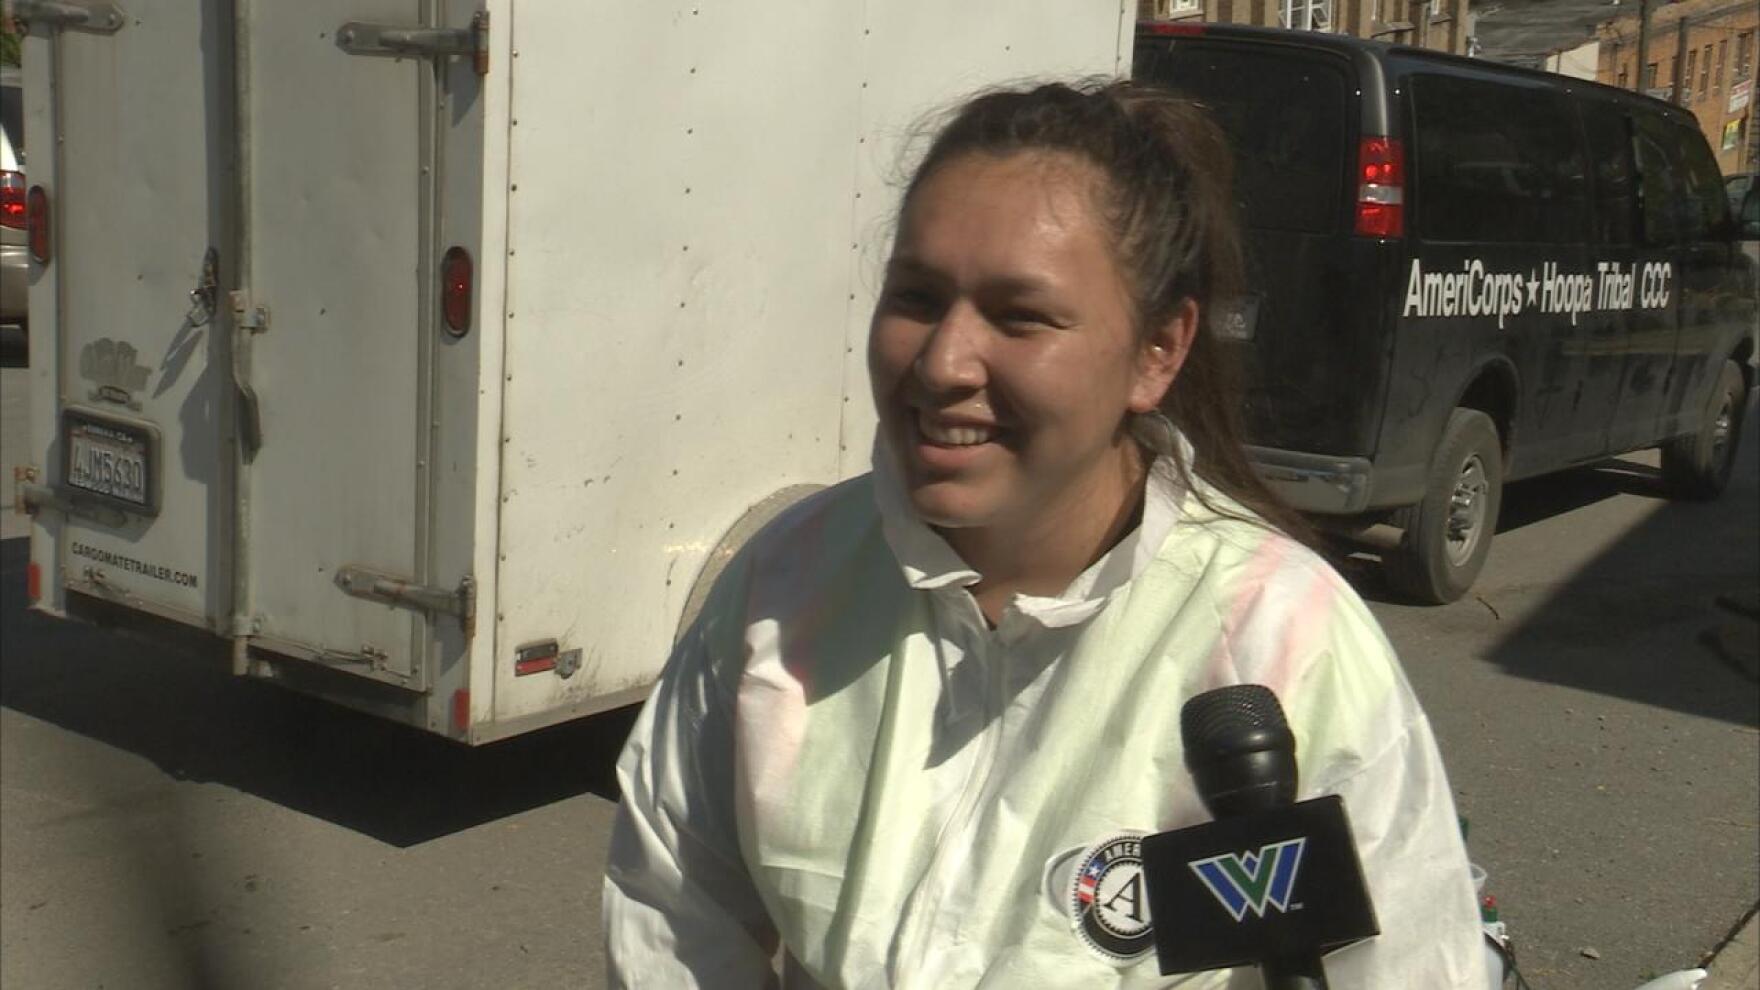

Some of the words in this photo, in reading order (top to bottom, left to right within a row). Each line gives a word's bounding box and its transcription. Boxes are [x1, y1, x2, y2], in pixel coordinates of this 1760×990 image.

[1403, 258, 1523, 329] AmeriCorps
[1540, 261, 1593, 326] Hoopa
[1597, 262, 1636, 310] Tribal
[1641, 261, 1672, 309] CCC
[71, 541, 198, 588] CARGOMATETRAILER.COM
[1104, 872, 1144, 923] A
